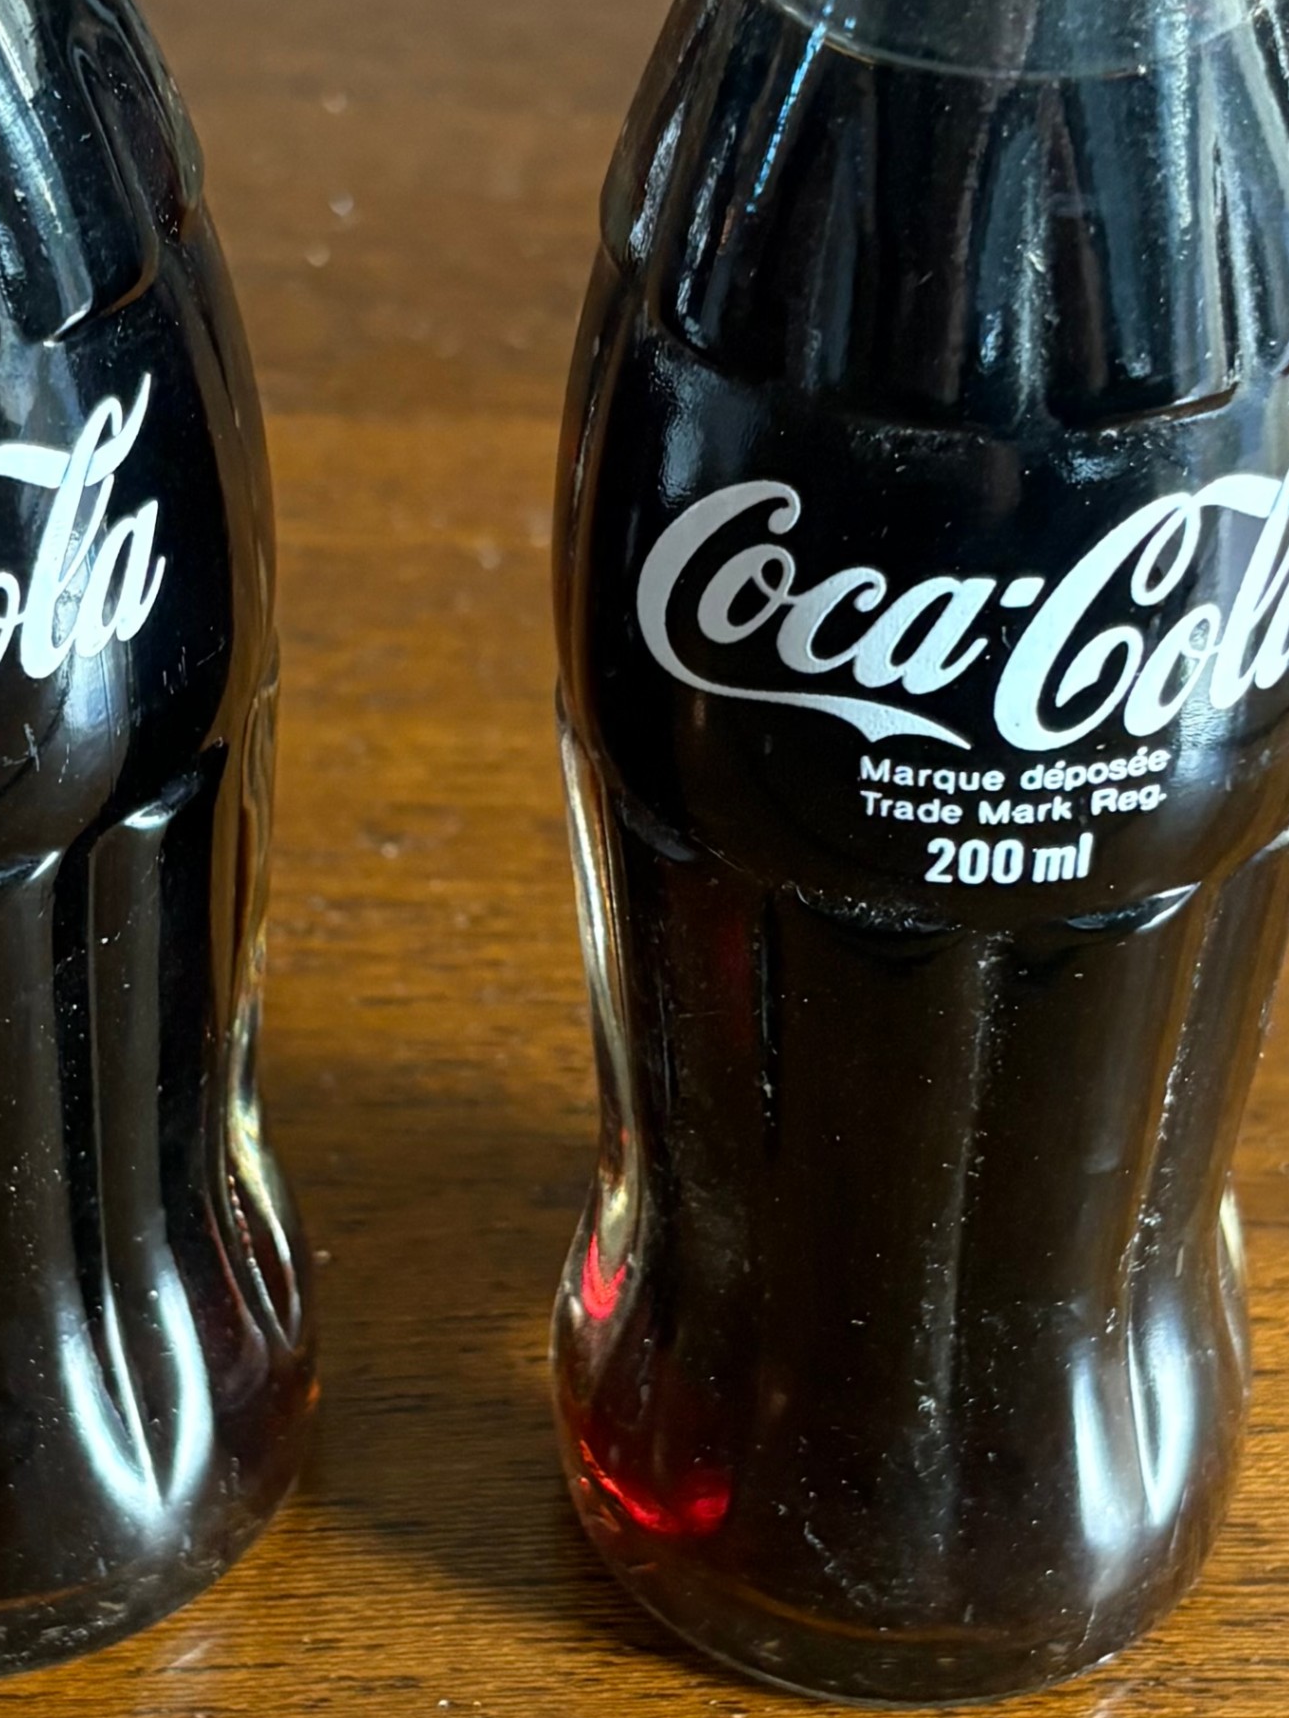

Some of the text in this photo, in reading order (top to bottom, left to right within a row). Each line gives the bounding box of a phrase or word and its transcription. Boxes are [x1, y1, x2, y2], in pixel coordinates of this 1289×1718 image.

[859, 747, 1172, 793] Marque déposée
[860, 787, 1167, 825] Trade Mark Reg.
[924, 832, 1095, 884] 200 ml
